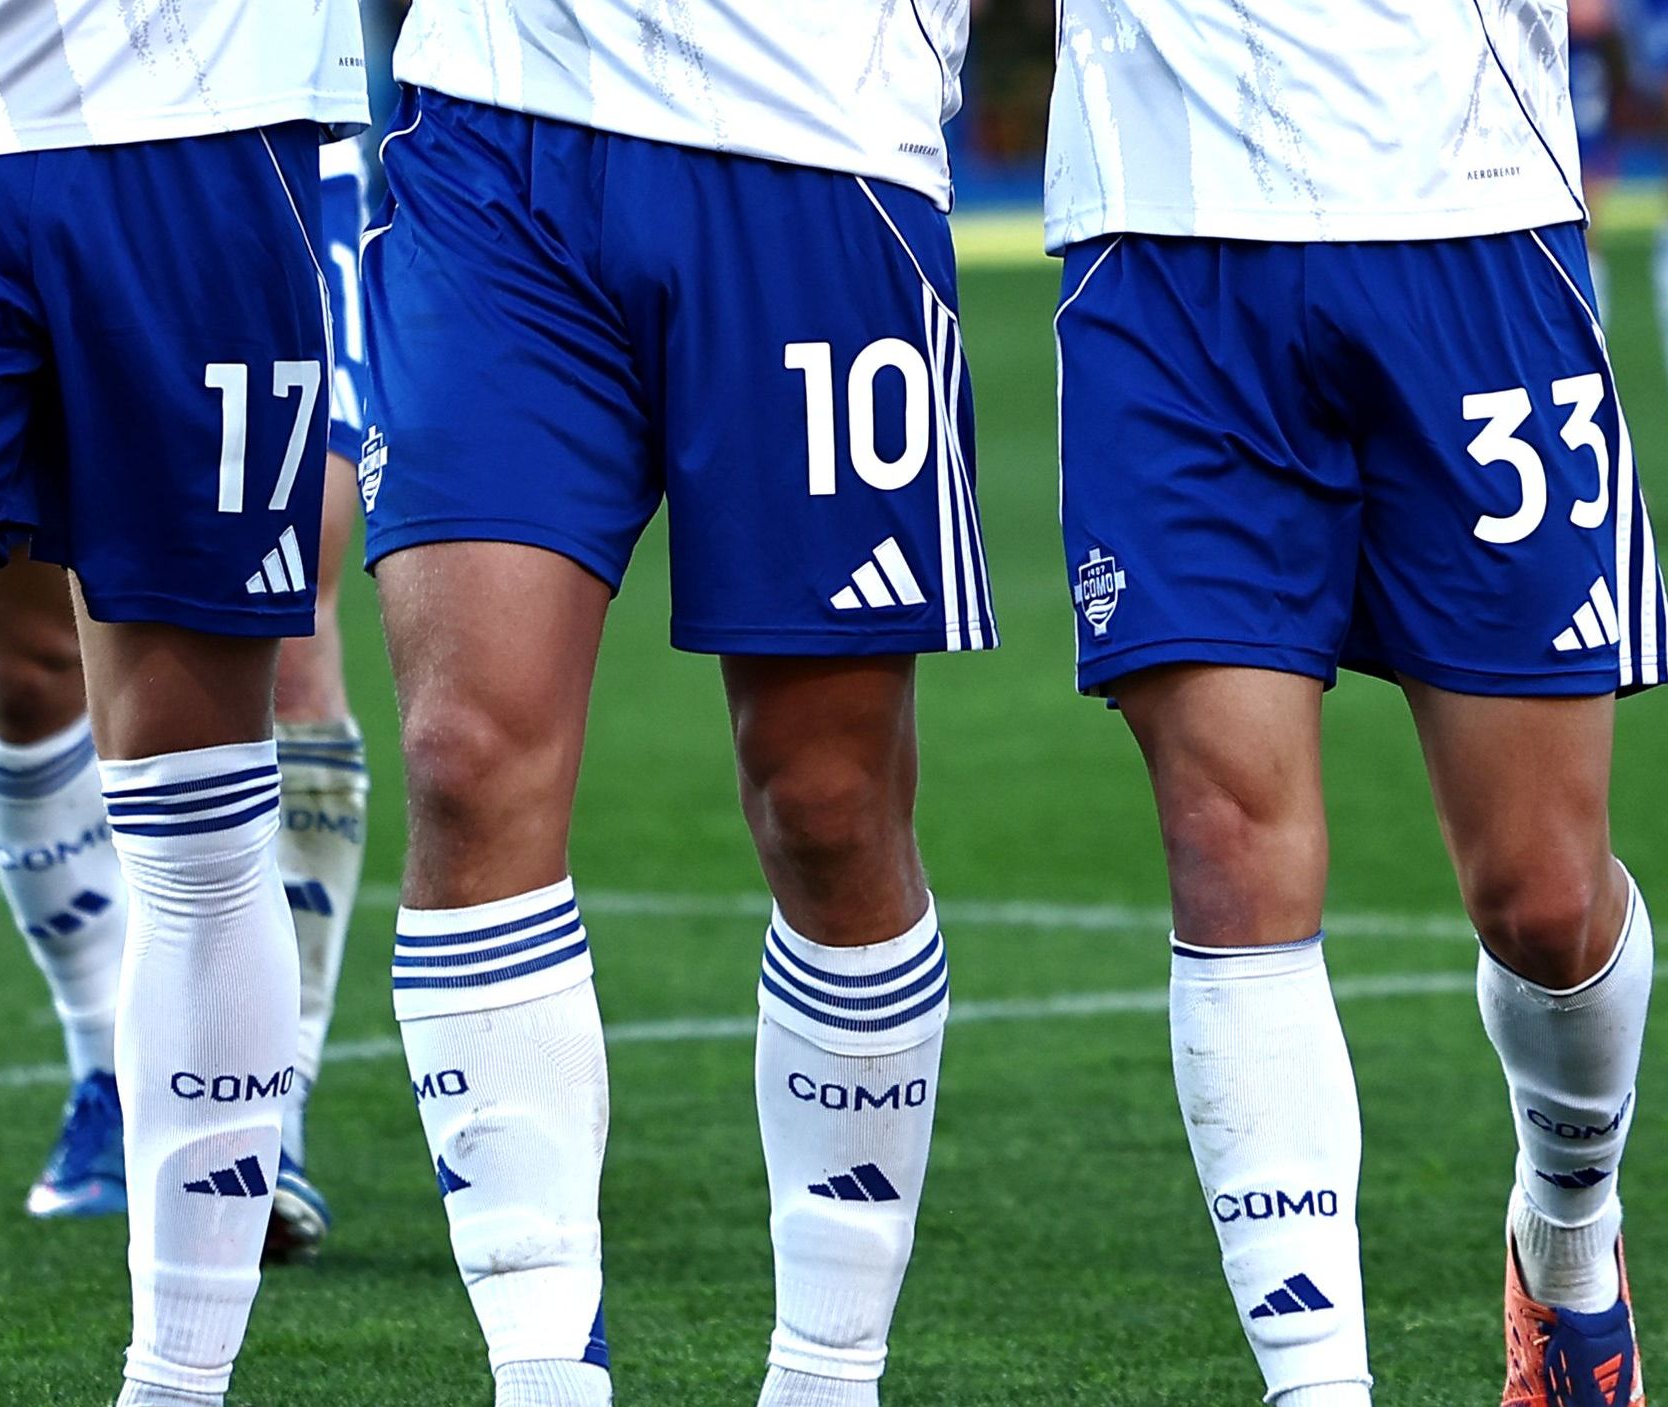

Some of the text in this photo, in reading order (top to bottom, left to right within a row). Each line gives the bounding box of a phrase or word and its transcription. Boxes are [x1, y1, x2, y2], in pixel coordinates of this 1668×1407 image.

[204, 360, 321, 513] 17
[784, 337, 930, 496] 10
[1462, 372, 1609, 544] 33
[1082, 573, 1115, 600] COMO
[170, 1066, 295, 1102] COMO
[788, 1072, 927, 1112] COMO
[1213, 1190, 1338, 1223] COMO
